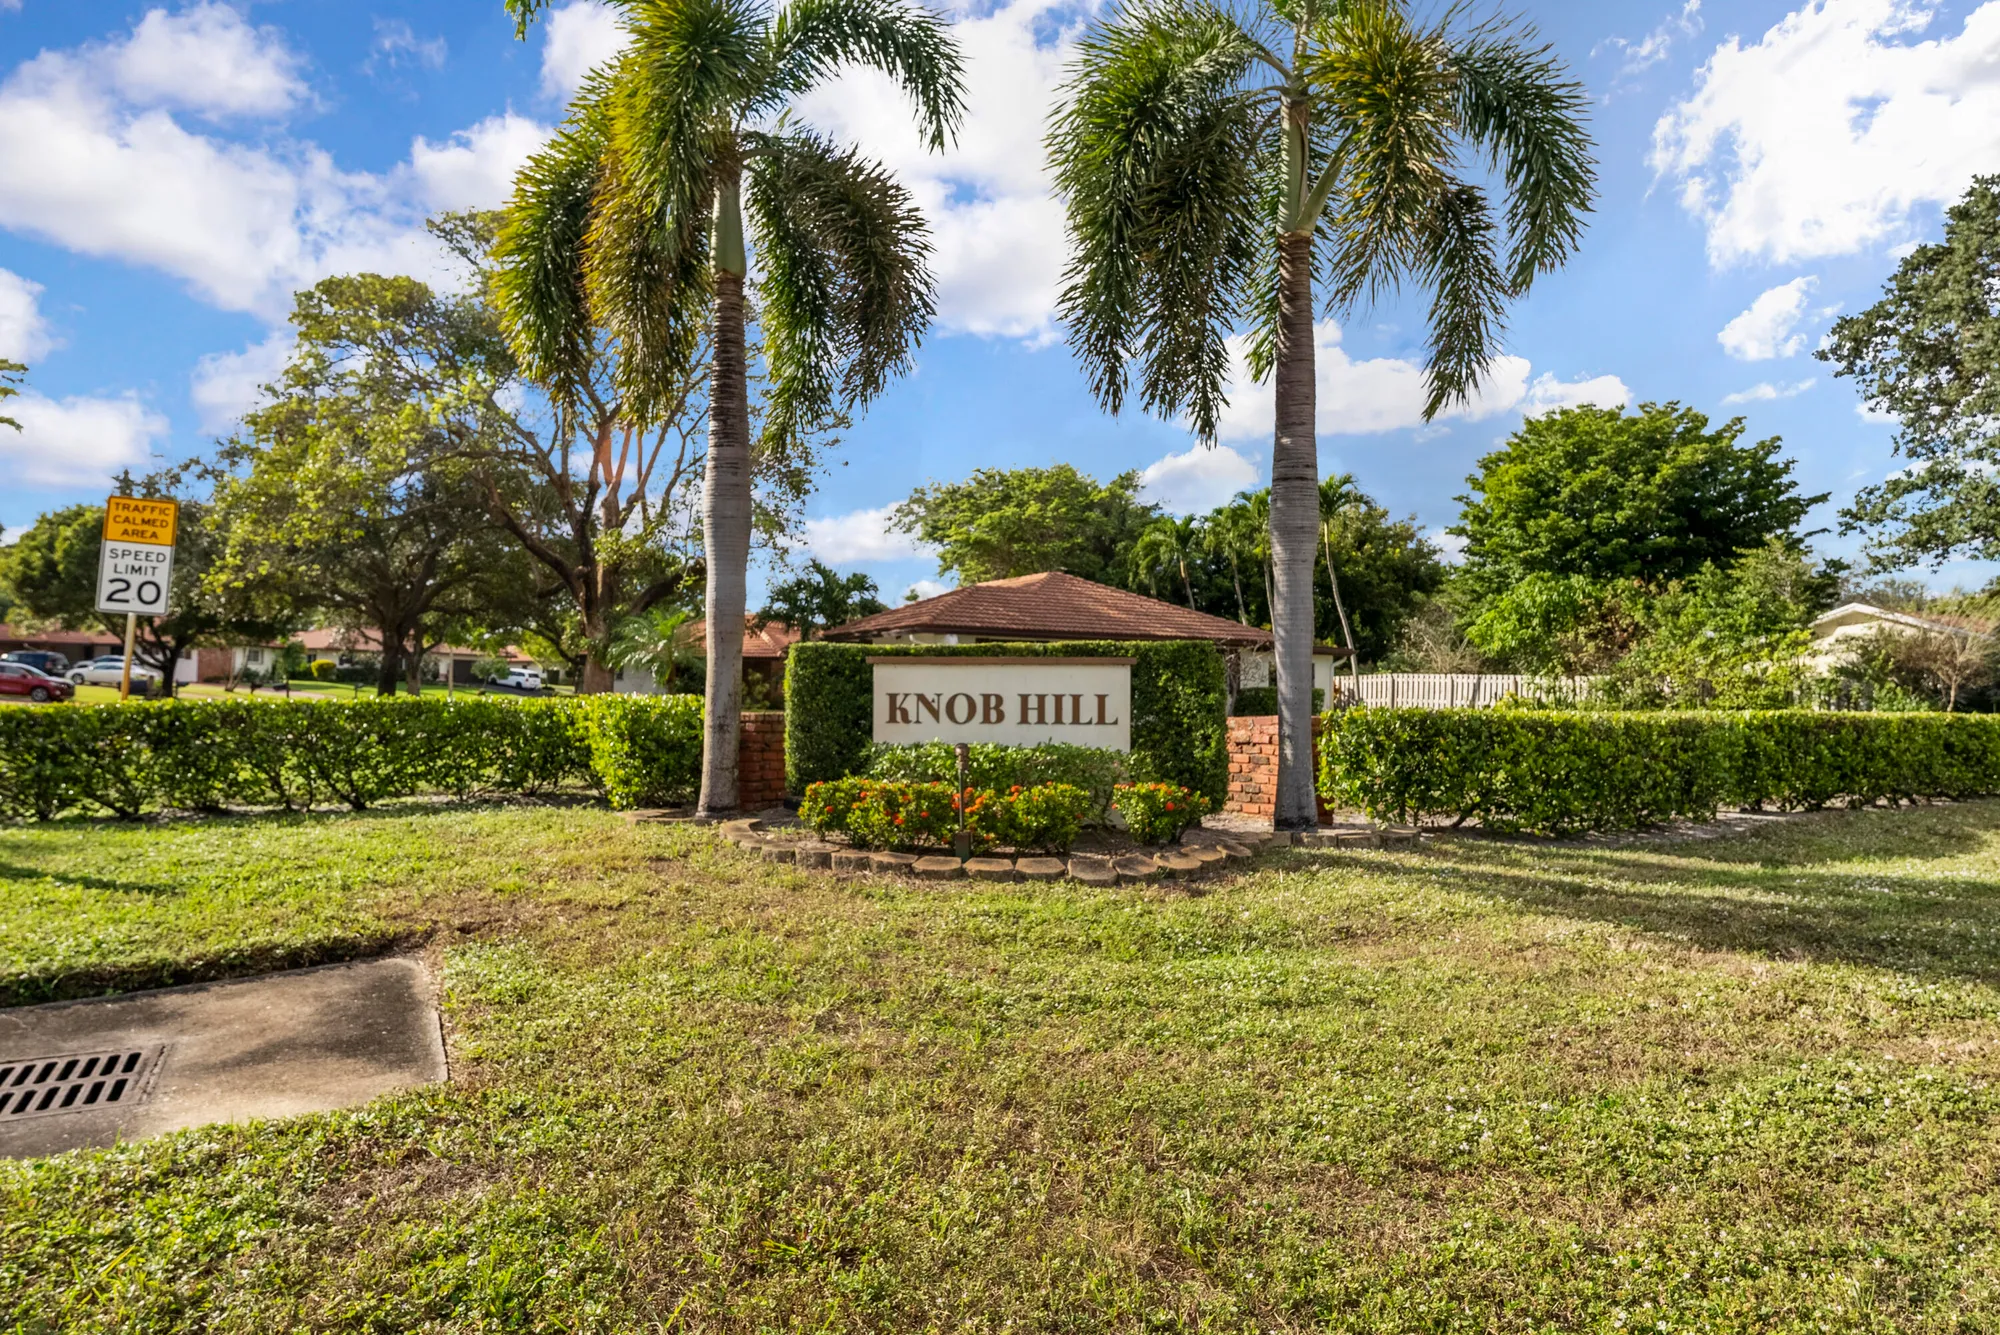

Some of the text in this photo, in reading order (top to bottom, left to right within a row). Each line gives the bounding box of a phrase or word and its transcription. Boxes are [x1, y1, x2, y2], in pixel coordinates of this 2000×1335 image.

[114, 502, 171, 516] TRAFFIC
[113, 515, 169, 528] CALMED
[120, 528, 159, 539] AREA
[109, 548, 167, 563] SPEED
[113, 563, 159, 576] LIMIT
[105, 578, 161, 605] 20
[885, 692, 1119, 725] KNOB HILL
